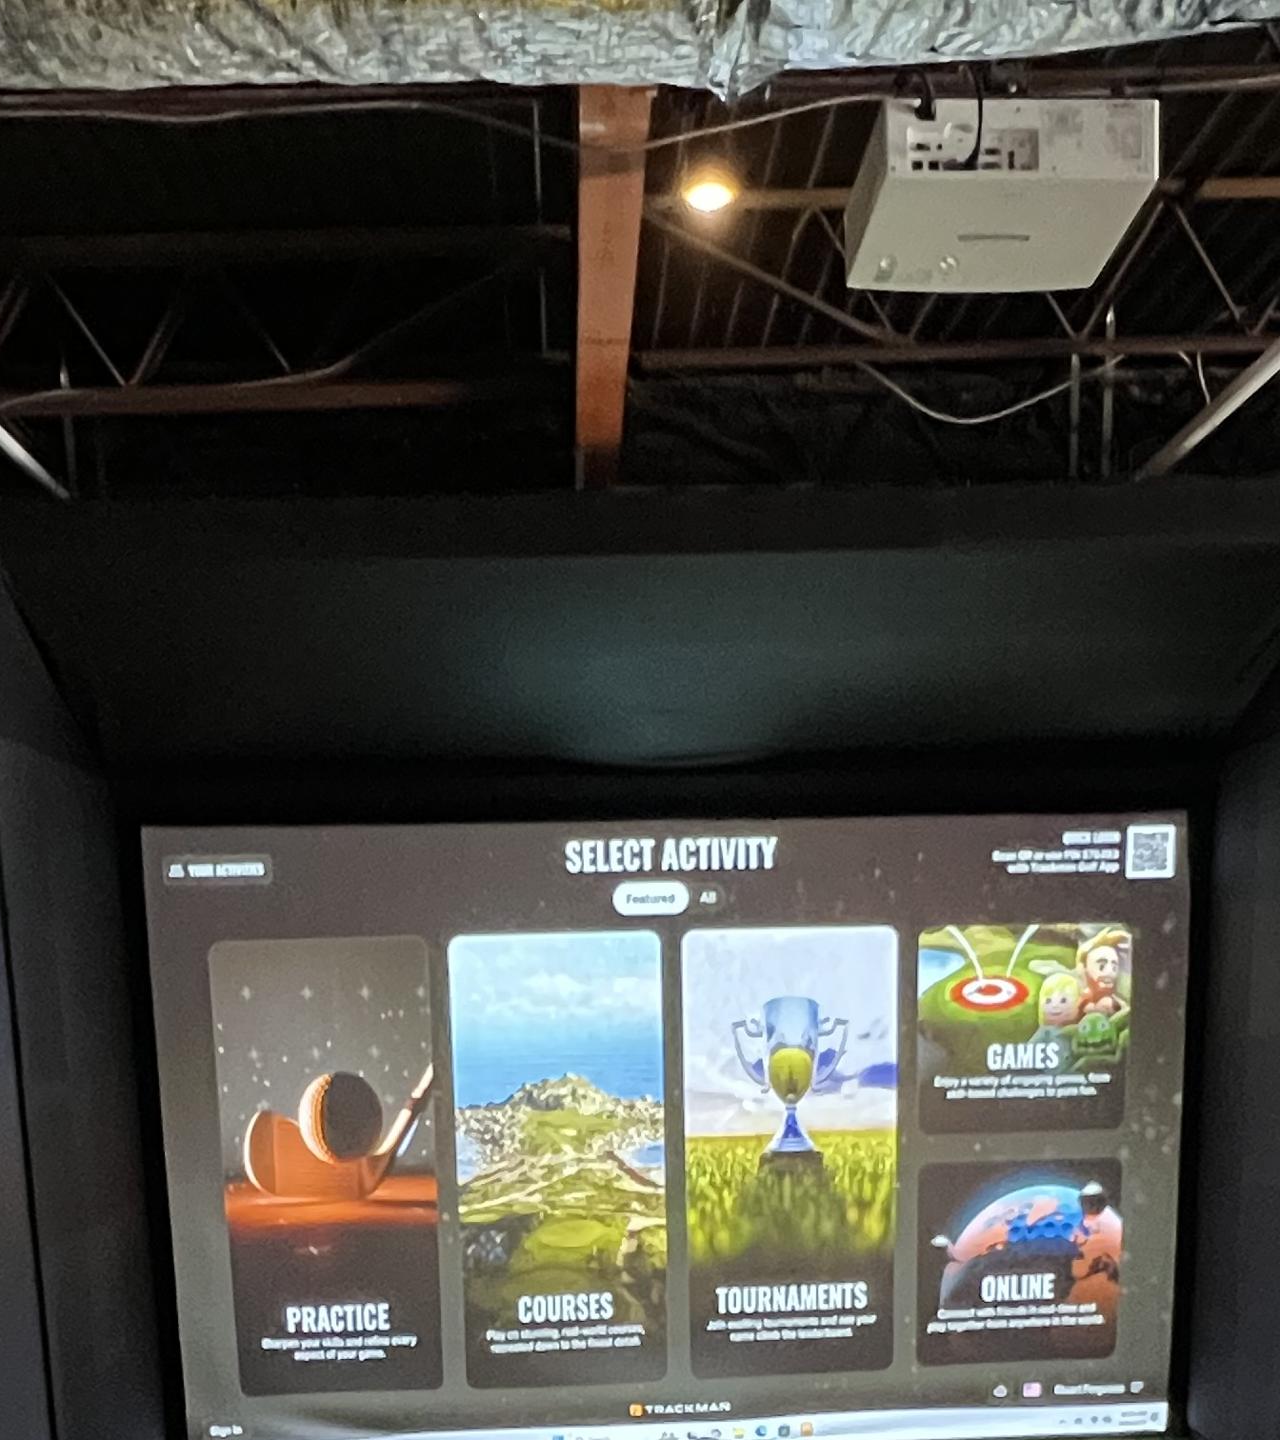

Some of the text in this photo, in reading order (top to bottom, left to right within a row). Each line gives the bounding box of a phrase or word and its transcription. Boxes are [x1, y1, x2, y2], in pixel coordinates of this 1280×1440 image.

[564, 836, 778, 873] SELECT ACTIVITY
[626, 893, 675, 904] Featured
[987, 1043, 1060, 1071] GAMES
[715, 1281, 868, 1314] TOURNAMENTS
[980, 1273, 1056, 1302] ONLINE
[285, 1303, 391, 1334] PRACTICE
[517, 1292, 614, 1323] COURSES
[644, 1401, 732, 1414] TRACKMAN
